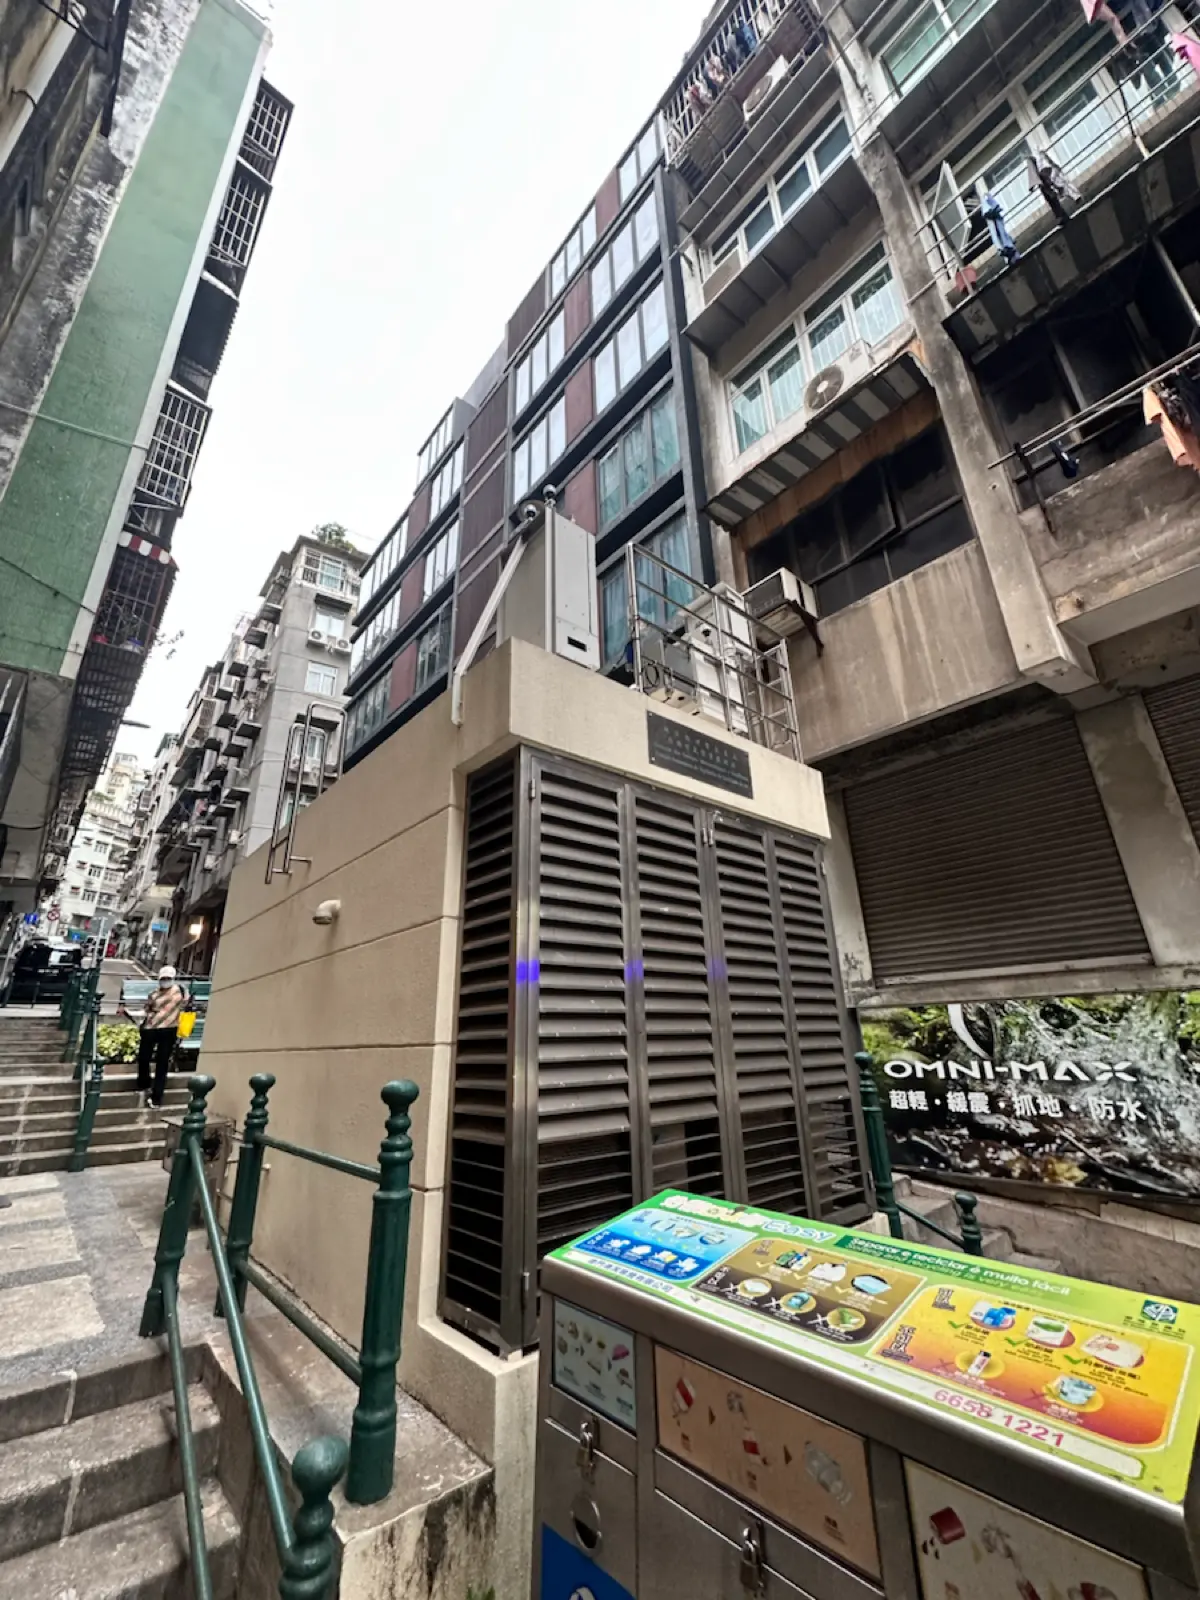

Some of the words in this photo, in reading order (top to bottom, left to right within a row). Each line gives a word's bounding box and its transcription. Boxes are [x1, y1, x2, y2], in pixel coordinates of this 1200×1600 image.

[884, 1059, 1137, 1082] OMNI-MAX
[852, 1238, 900, 1254] Separar
[901, 1250, 912, 1258] e
[912, 1253, 968, 1271] reciclar
[934, 1388, 993, 1418] 6658
[1003, 1415, 1065, 1448] 1221
